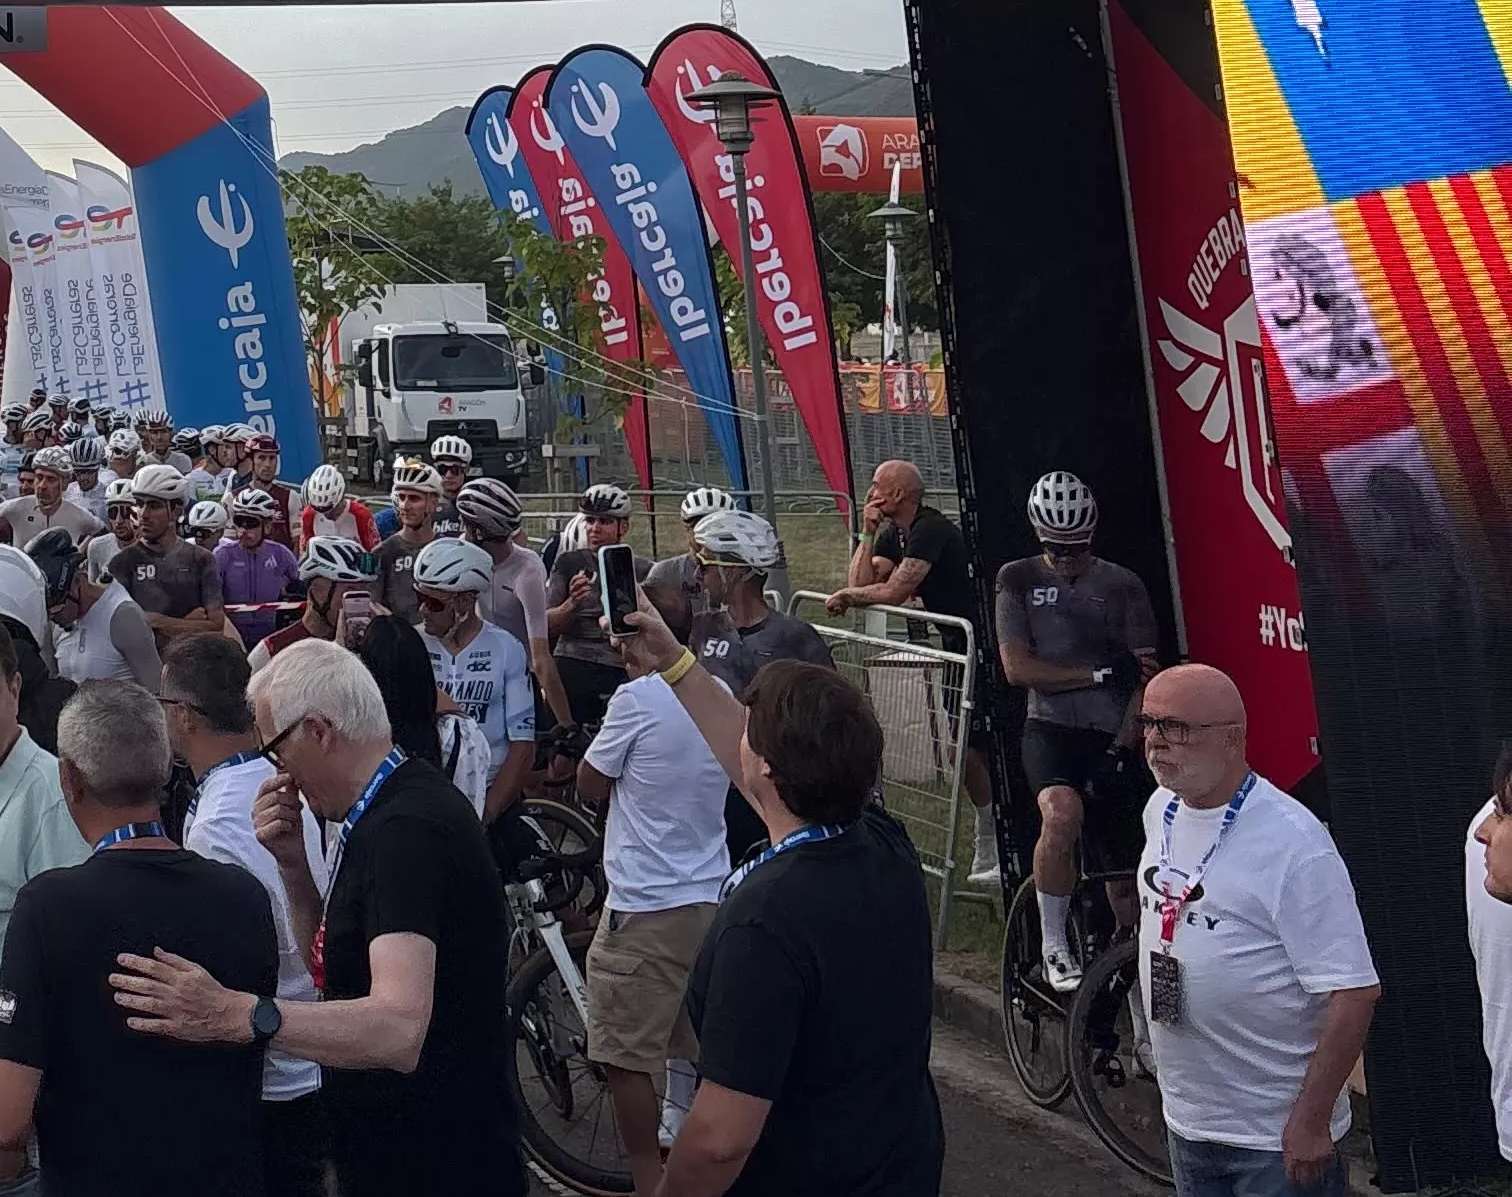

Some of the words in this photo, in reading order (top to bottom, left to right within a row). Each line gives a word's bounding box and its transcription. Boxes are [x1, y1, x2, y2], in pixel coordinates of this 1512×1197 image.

[882, 133, 920, 150] ARA
[1187, 207, 1247, 310] QUEBRA
[218, 281, 278, 437] ercaja
